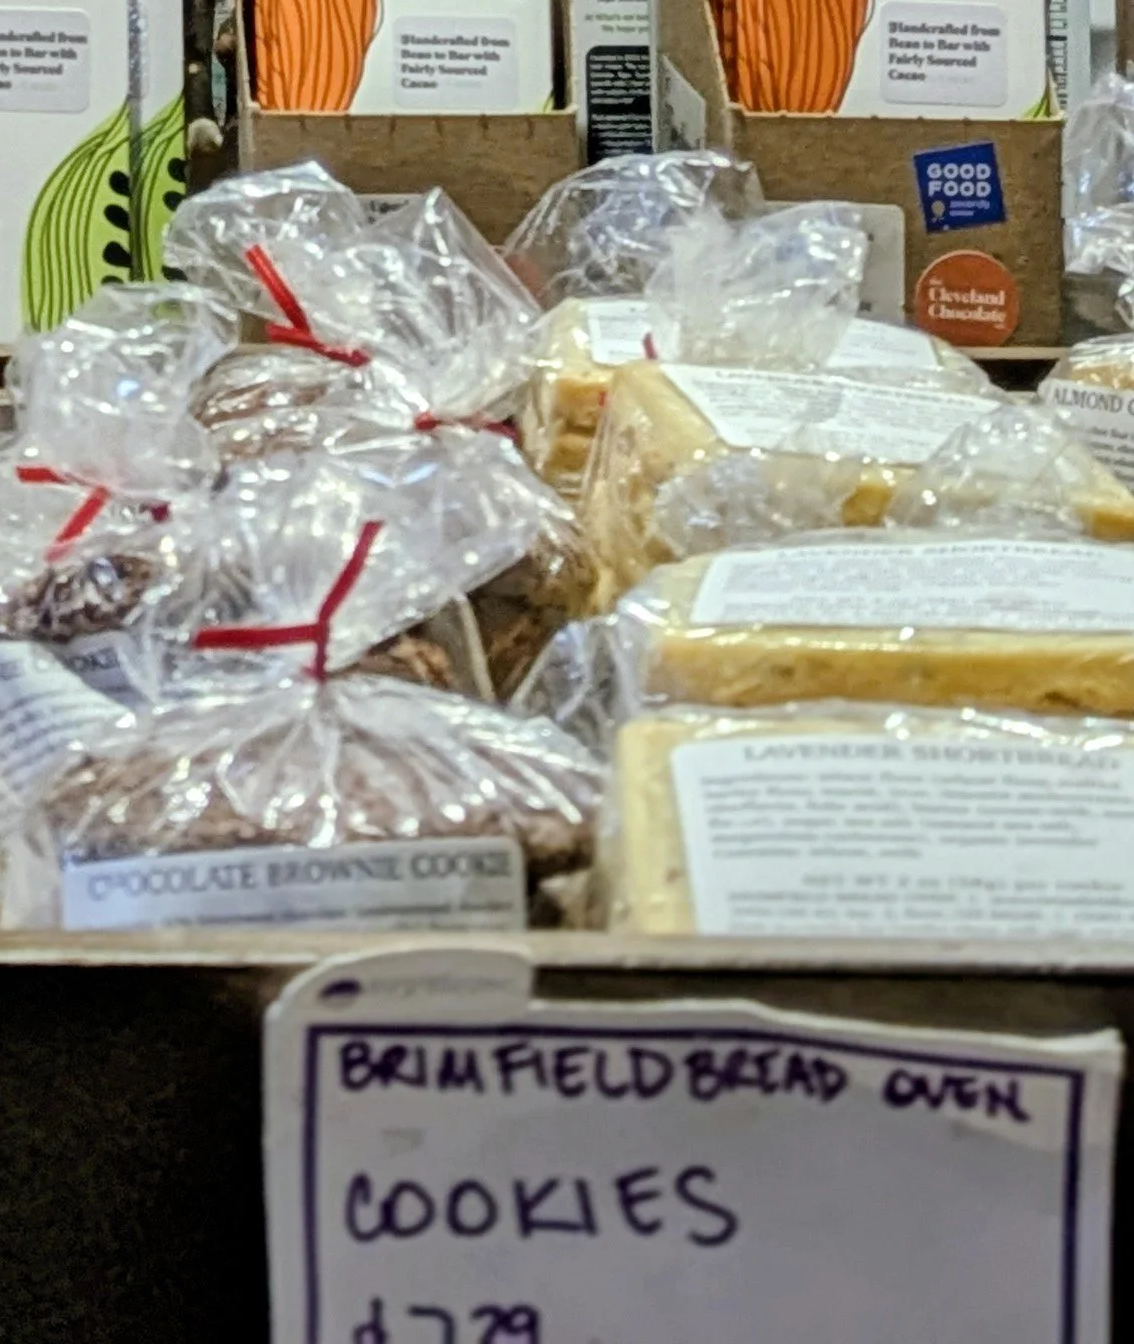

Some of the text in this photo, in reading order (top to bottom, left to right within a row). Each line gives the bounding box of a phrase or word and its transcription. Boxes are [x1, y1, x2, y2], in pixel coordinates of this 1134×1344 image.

[971, 24, 1001, 36] from
[58, 32, 88, 44] from
[481, 35, 511, 47] from
[889, 38, 990, 51] Bean to Bar with
[10, 49, 22, 58] to
[24, 47, 47, 58] Bar
[49, 49, 78, 60] with
[401, 49, 501, 61] Bean to Bar with
[889, 53, 976, 68] Fairly Sourced
[13, 64, 63, 75] Sourced
[401, 63, 488, 76] Fairly Sourced
[888, 69, 926, 81] Cacao
[401, 78, 438, 89] Cacao
[927, 163, 991, 179] GOOD
[928, 180, 991, 197] FOOD
[928, 286, 1006, 306] Cleveland
[927, 302, 1007, 323] Chocolate
[268, 857, 402, 887] BROWNIE
[411, 850, 513, 879] COOKIE
[882, 1068, 1032, 1123] OVEN
[344, 1165, 740, 1247] COOKIES
